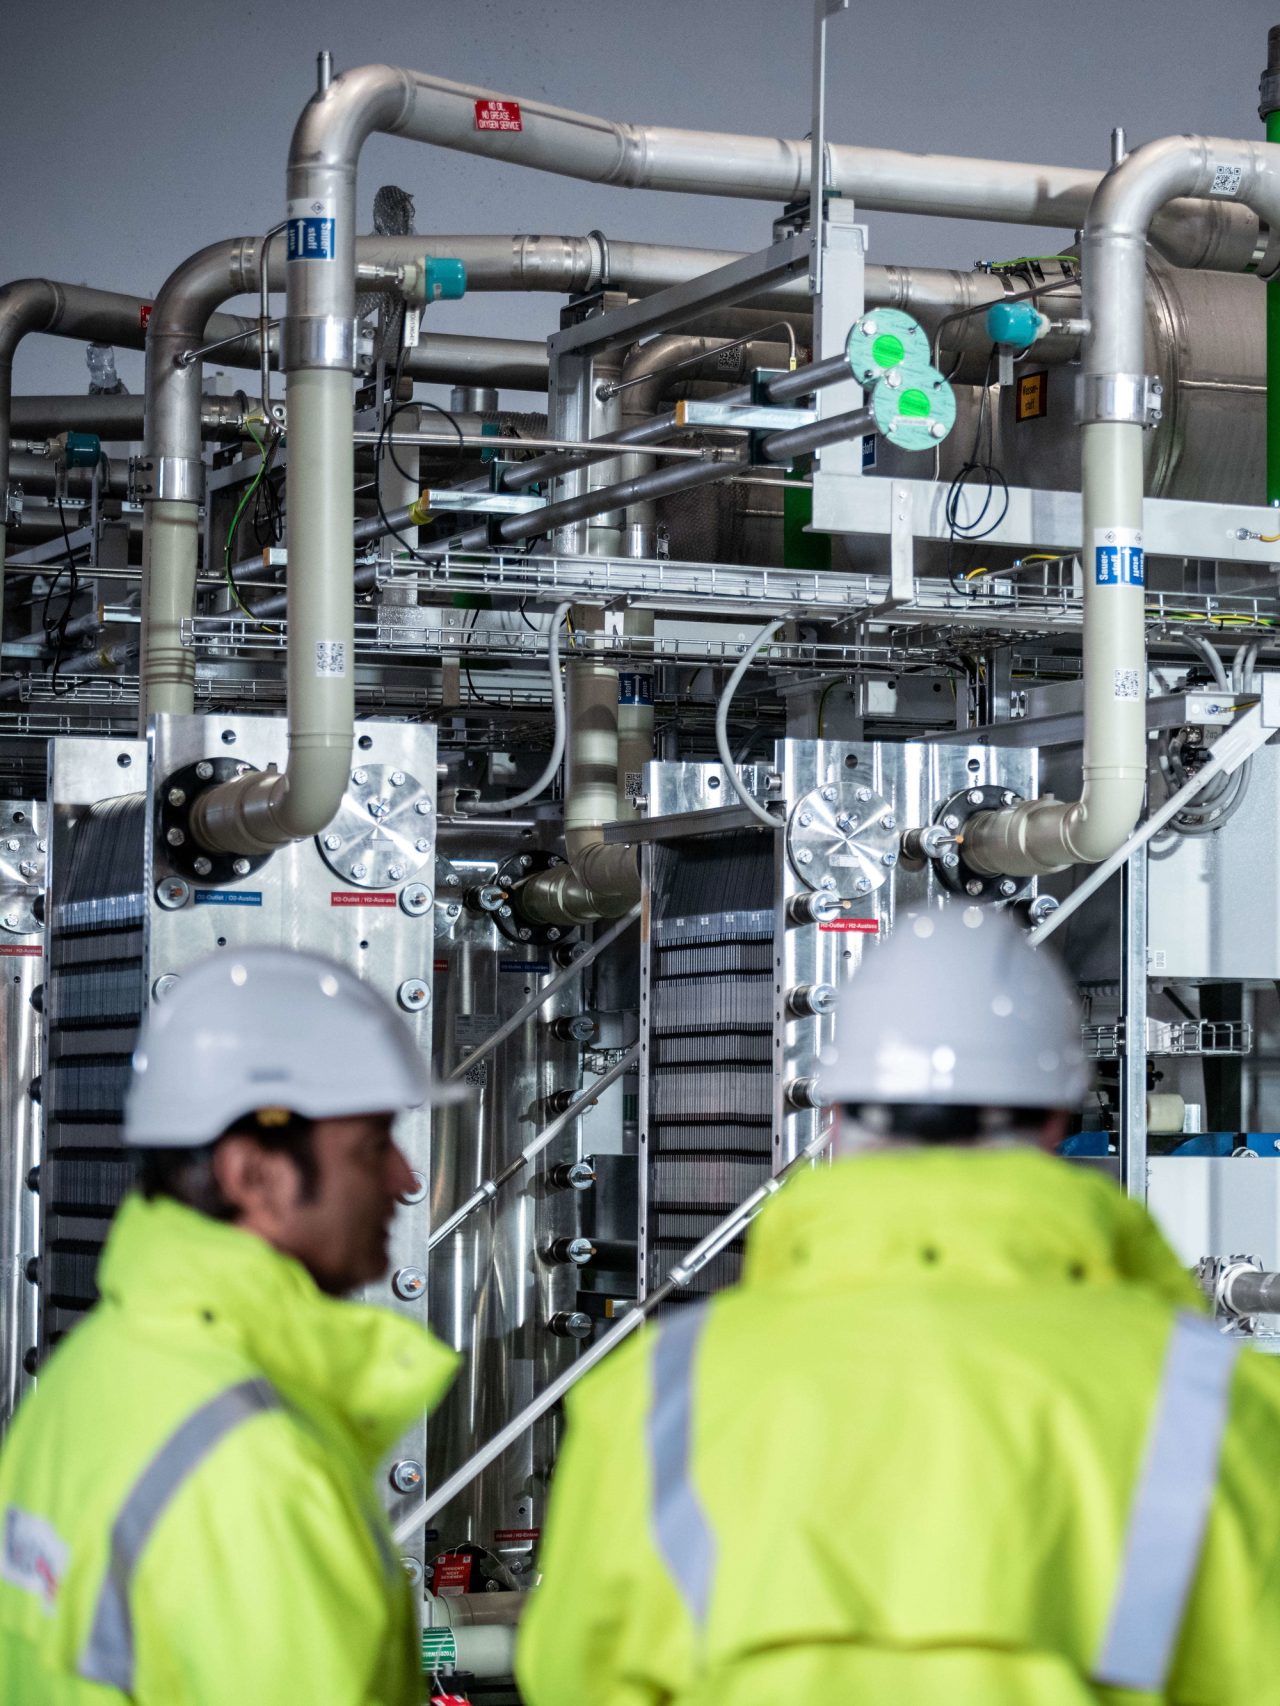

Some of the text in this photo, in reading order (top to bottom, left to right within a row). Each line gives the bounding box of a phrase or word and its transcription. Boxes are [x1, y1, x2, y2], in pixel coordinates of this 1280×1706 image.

[488, 102, 496, 110] NO
[481, 110, 490, 120] NO
[490, 111, 510, 120] GREASE
[478, 120, 520, 130] OXYGEN SERVICE
[1099, 551, 1109, 581] Sauer-
